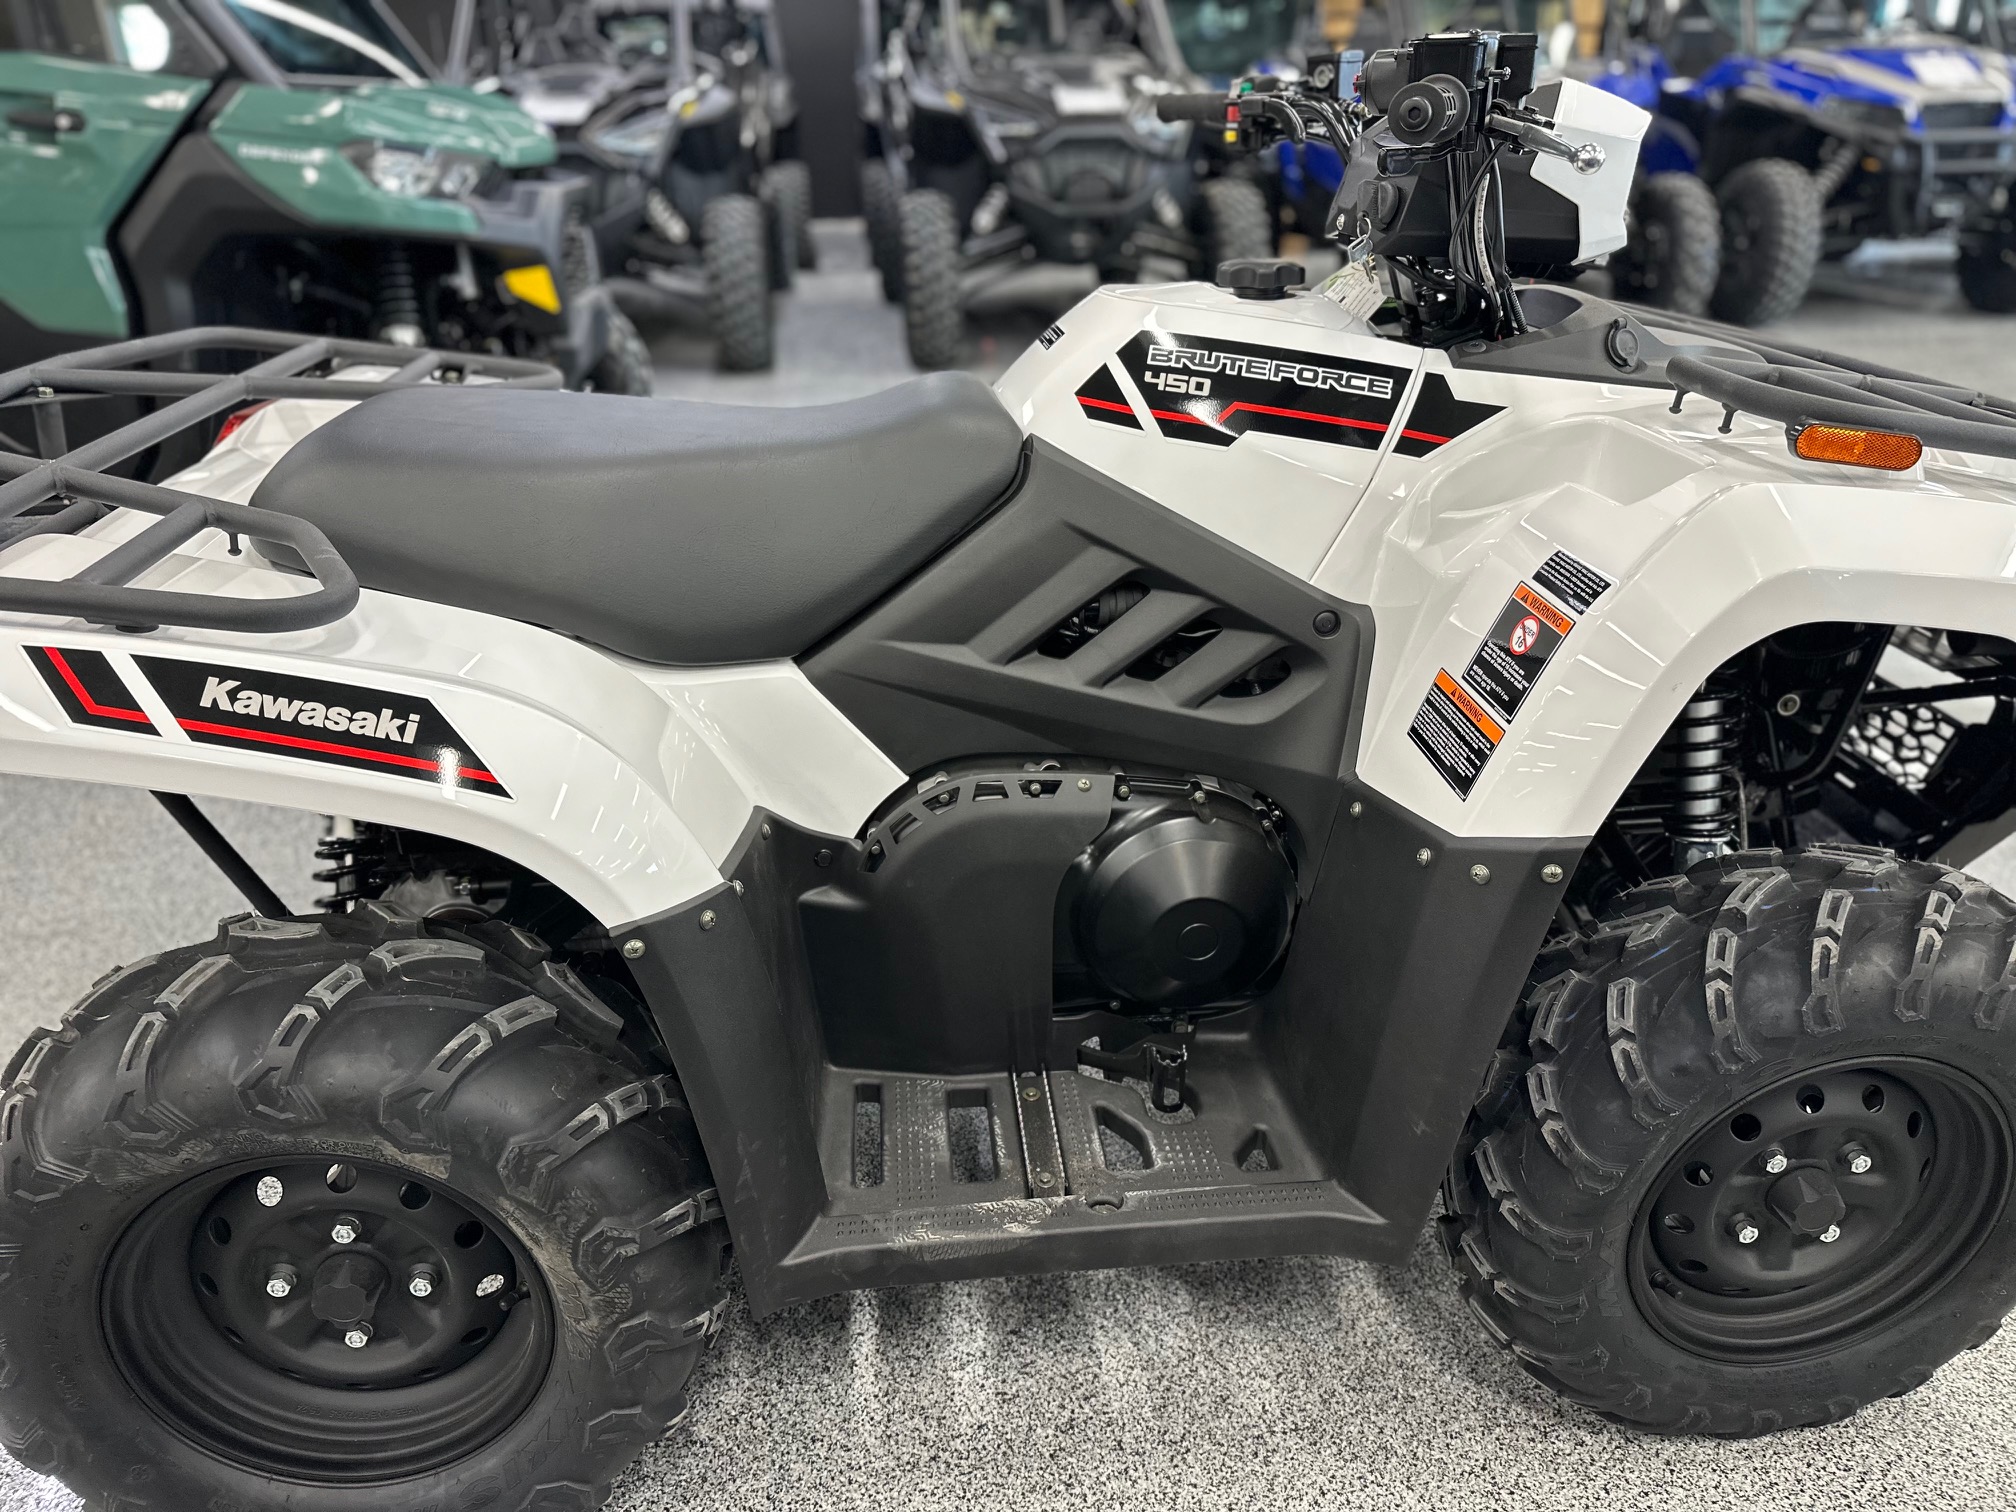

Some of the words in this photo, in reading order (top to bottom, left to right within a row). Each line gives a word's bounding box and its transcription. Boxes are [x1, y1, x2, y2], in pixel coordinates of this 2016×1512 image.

[1144, 371, 1211, 396] 450
[1148, 345, 1270, 379] BRUTE
[1271, 363, 1393, 398] FORCE
[1528, 596, 1564, 628] WARNING
[1514, 634, 1525, 648] 16
[199, 677, 421, 744] Kawasaki
[1455, 691, 1483, 723] WARNING
